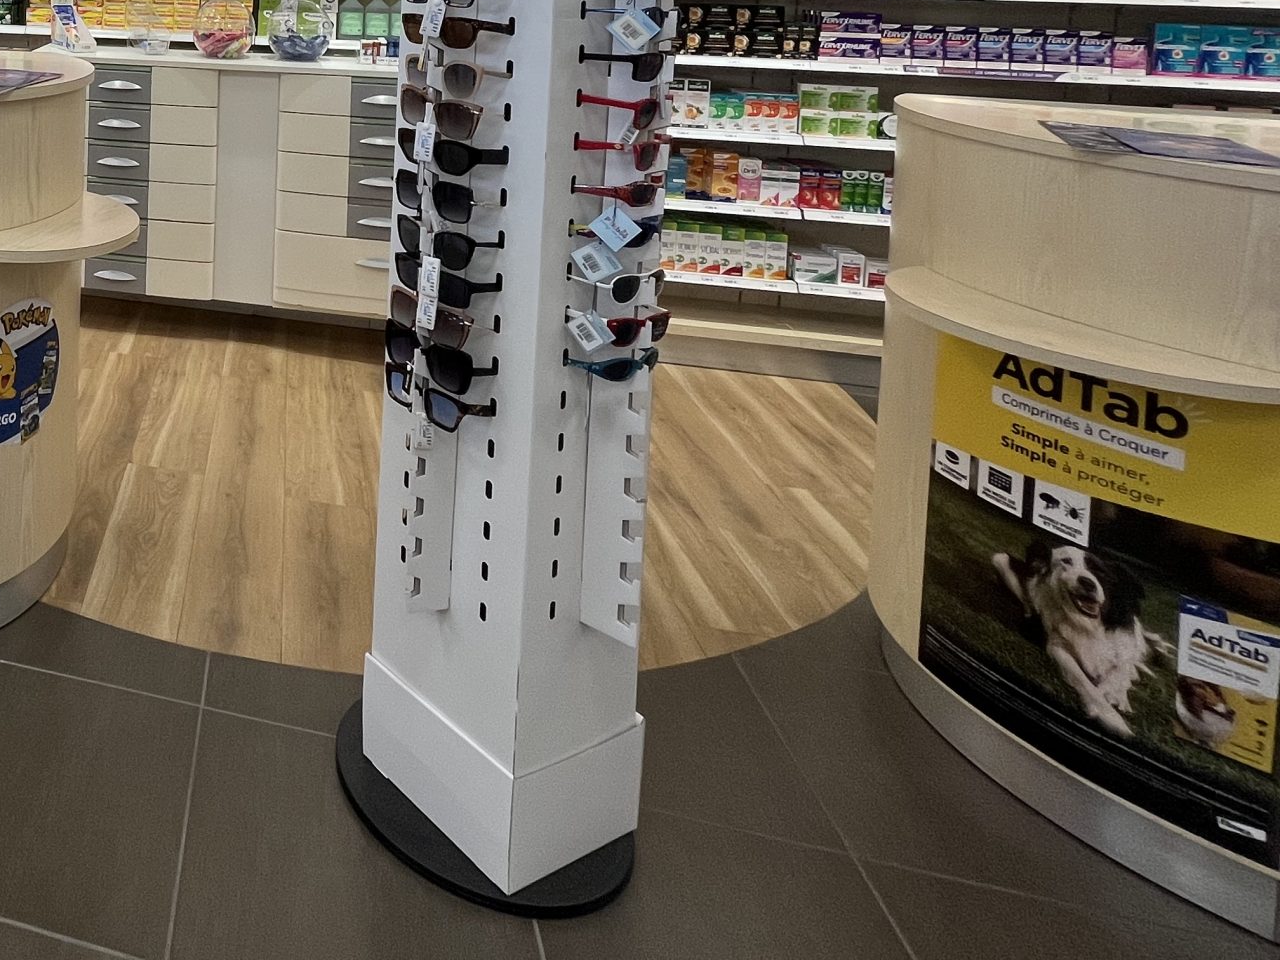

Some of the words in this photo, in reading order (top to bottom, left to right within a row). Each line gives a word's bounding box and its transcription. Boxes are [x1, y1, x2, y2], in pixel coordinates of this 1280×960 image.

[0, 303, 52, 336] Pokémon
[991, 352, 1190, 440] AdTab
[1001, 392, 1081, 431] Comprimés
[1084, 422, 1094, 437] à
[1098, 427, 1169, 462] Croquer
[1010, 422, 1071, 456] Simple
[1075, 445, 1086, 462] à
[1000, 434, 1058, 469] Simple
[1062, 458, 1073, 475] à
[1076, 468, 1165, 508] protéger
[1191, 628, 1269, 664] AdTab
